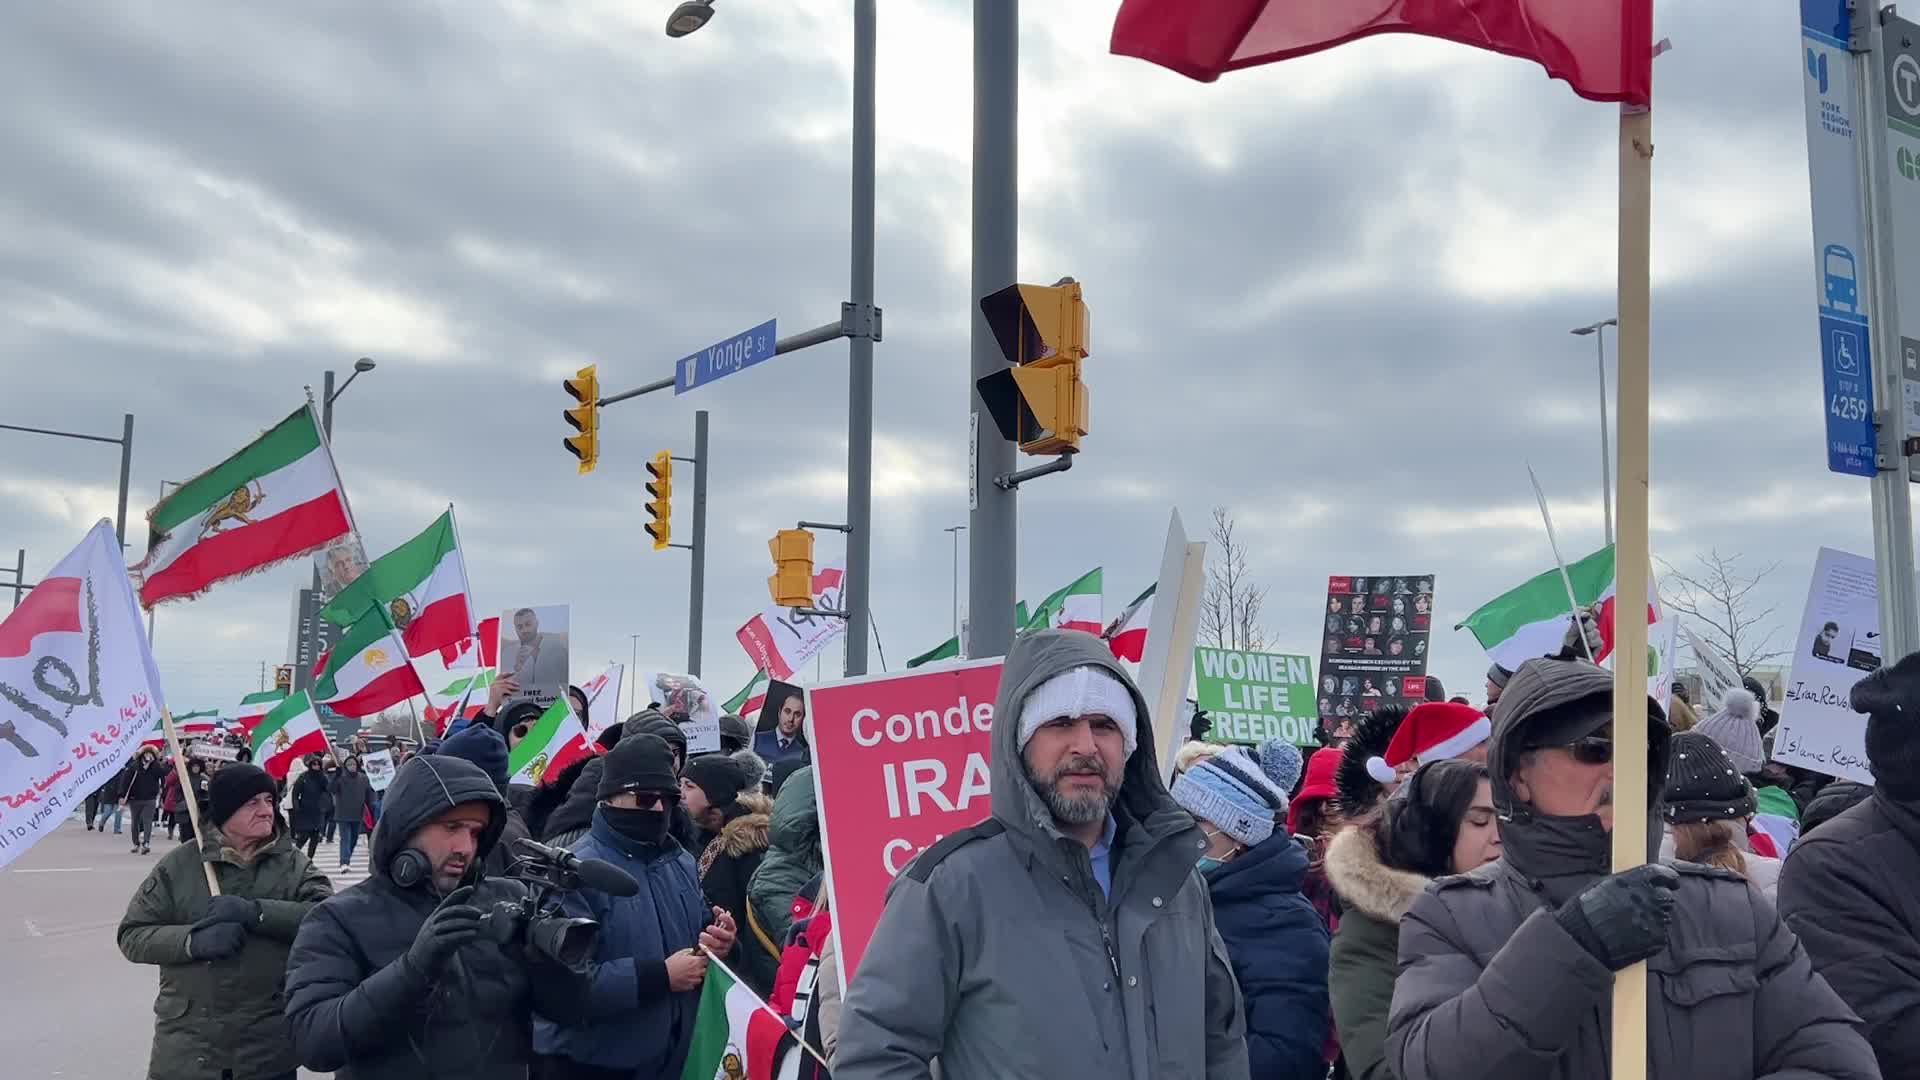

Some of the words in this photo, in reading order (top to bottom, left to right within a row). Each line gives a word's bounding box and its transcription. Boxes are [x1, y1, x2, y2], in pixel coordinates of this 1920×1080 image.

[1821, 101, 1840, 114] YORK
[1821, 110, 1850, 129] REGION
[1822, 120, 1853, 140] TRANSIT
[707, 335, 753, 374] Yonge
[1831, 393, 1867, 422] 4259
[1200, 649, 1308, 685] WOMEN
[1223, 683, 1291, 713] LIFE
[851, 695, 992, 748] Conde
[1778, 727, 1825, 763] Islamic
[882, 752, 992, 819] IRA
